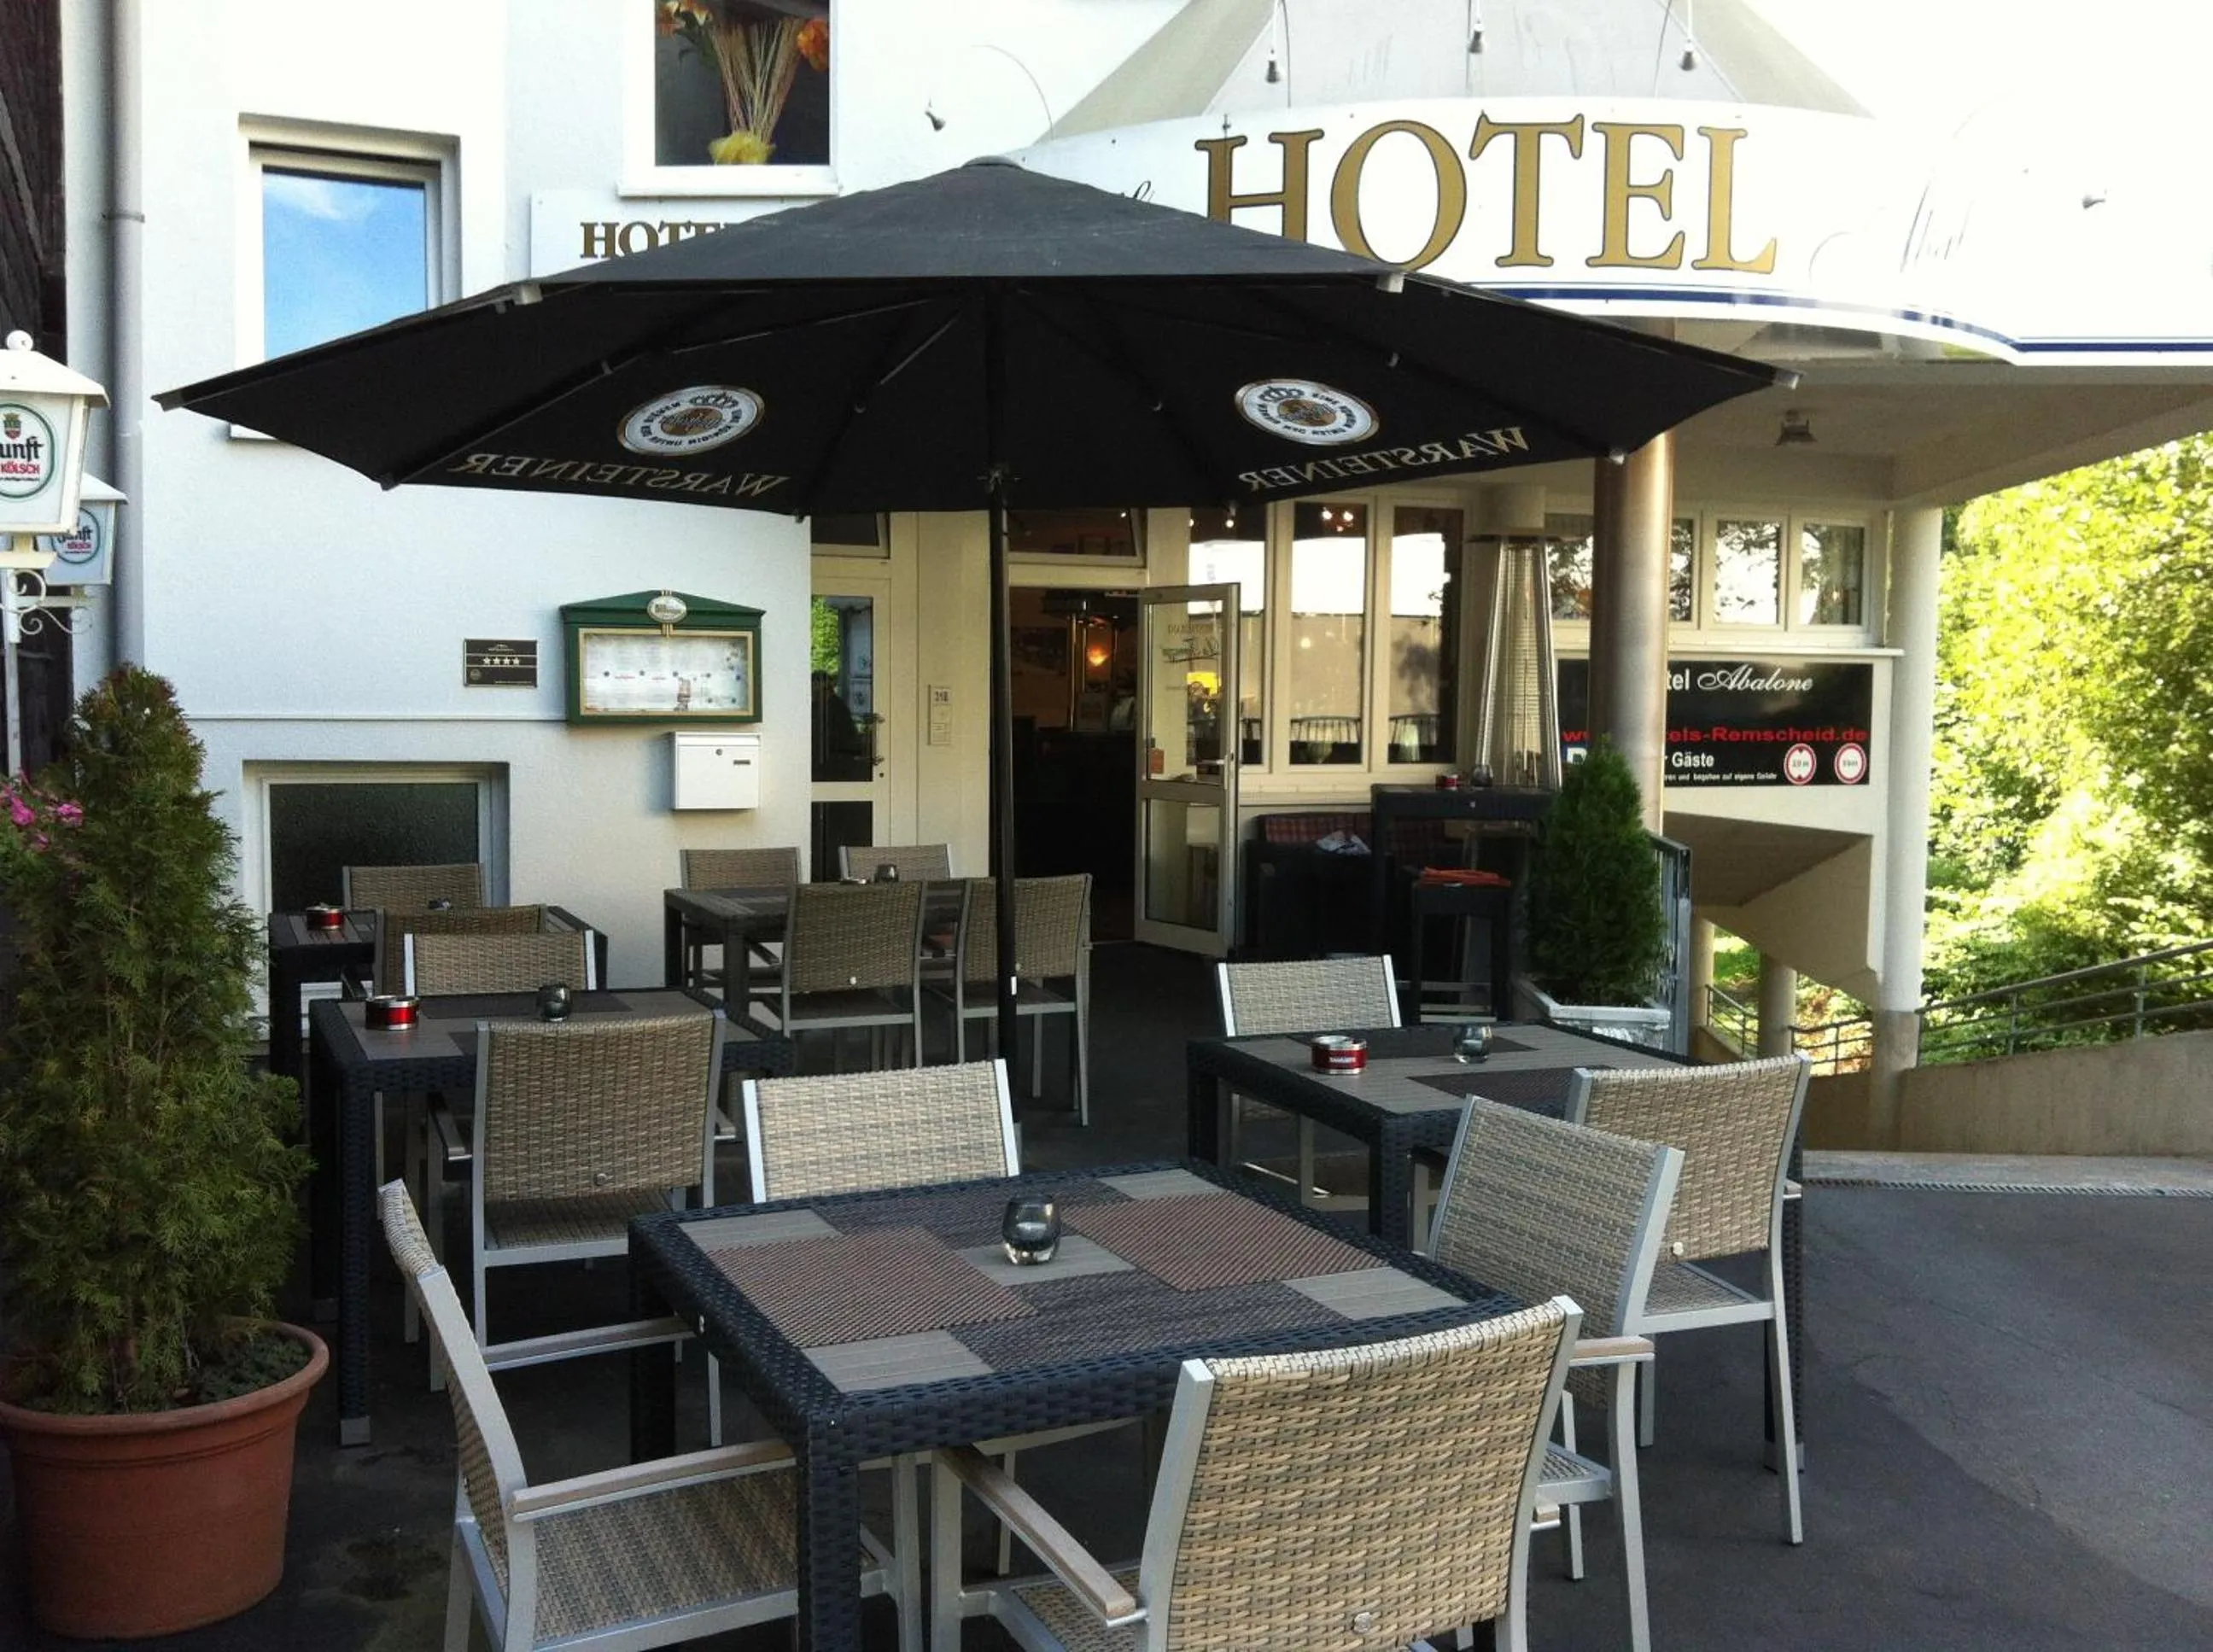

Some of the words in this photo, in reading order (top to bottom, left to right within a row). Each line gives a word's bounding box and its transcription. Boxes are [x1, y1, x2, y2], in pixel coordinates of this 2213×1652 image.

[1194, 113, 1778, 273] HOTEL
[580, 219, 739, 259] HOT
[0, 436, 44, 462] unft
[1, 461, 41, 475] KÖLSCH
[1667, 668, 1690, 691] tel
[1697, 663, 1813, 692] Abalone
[1672, 751, 1715, 768] Gäste
